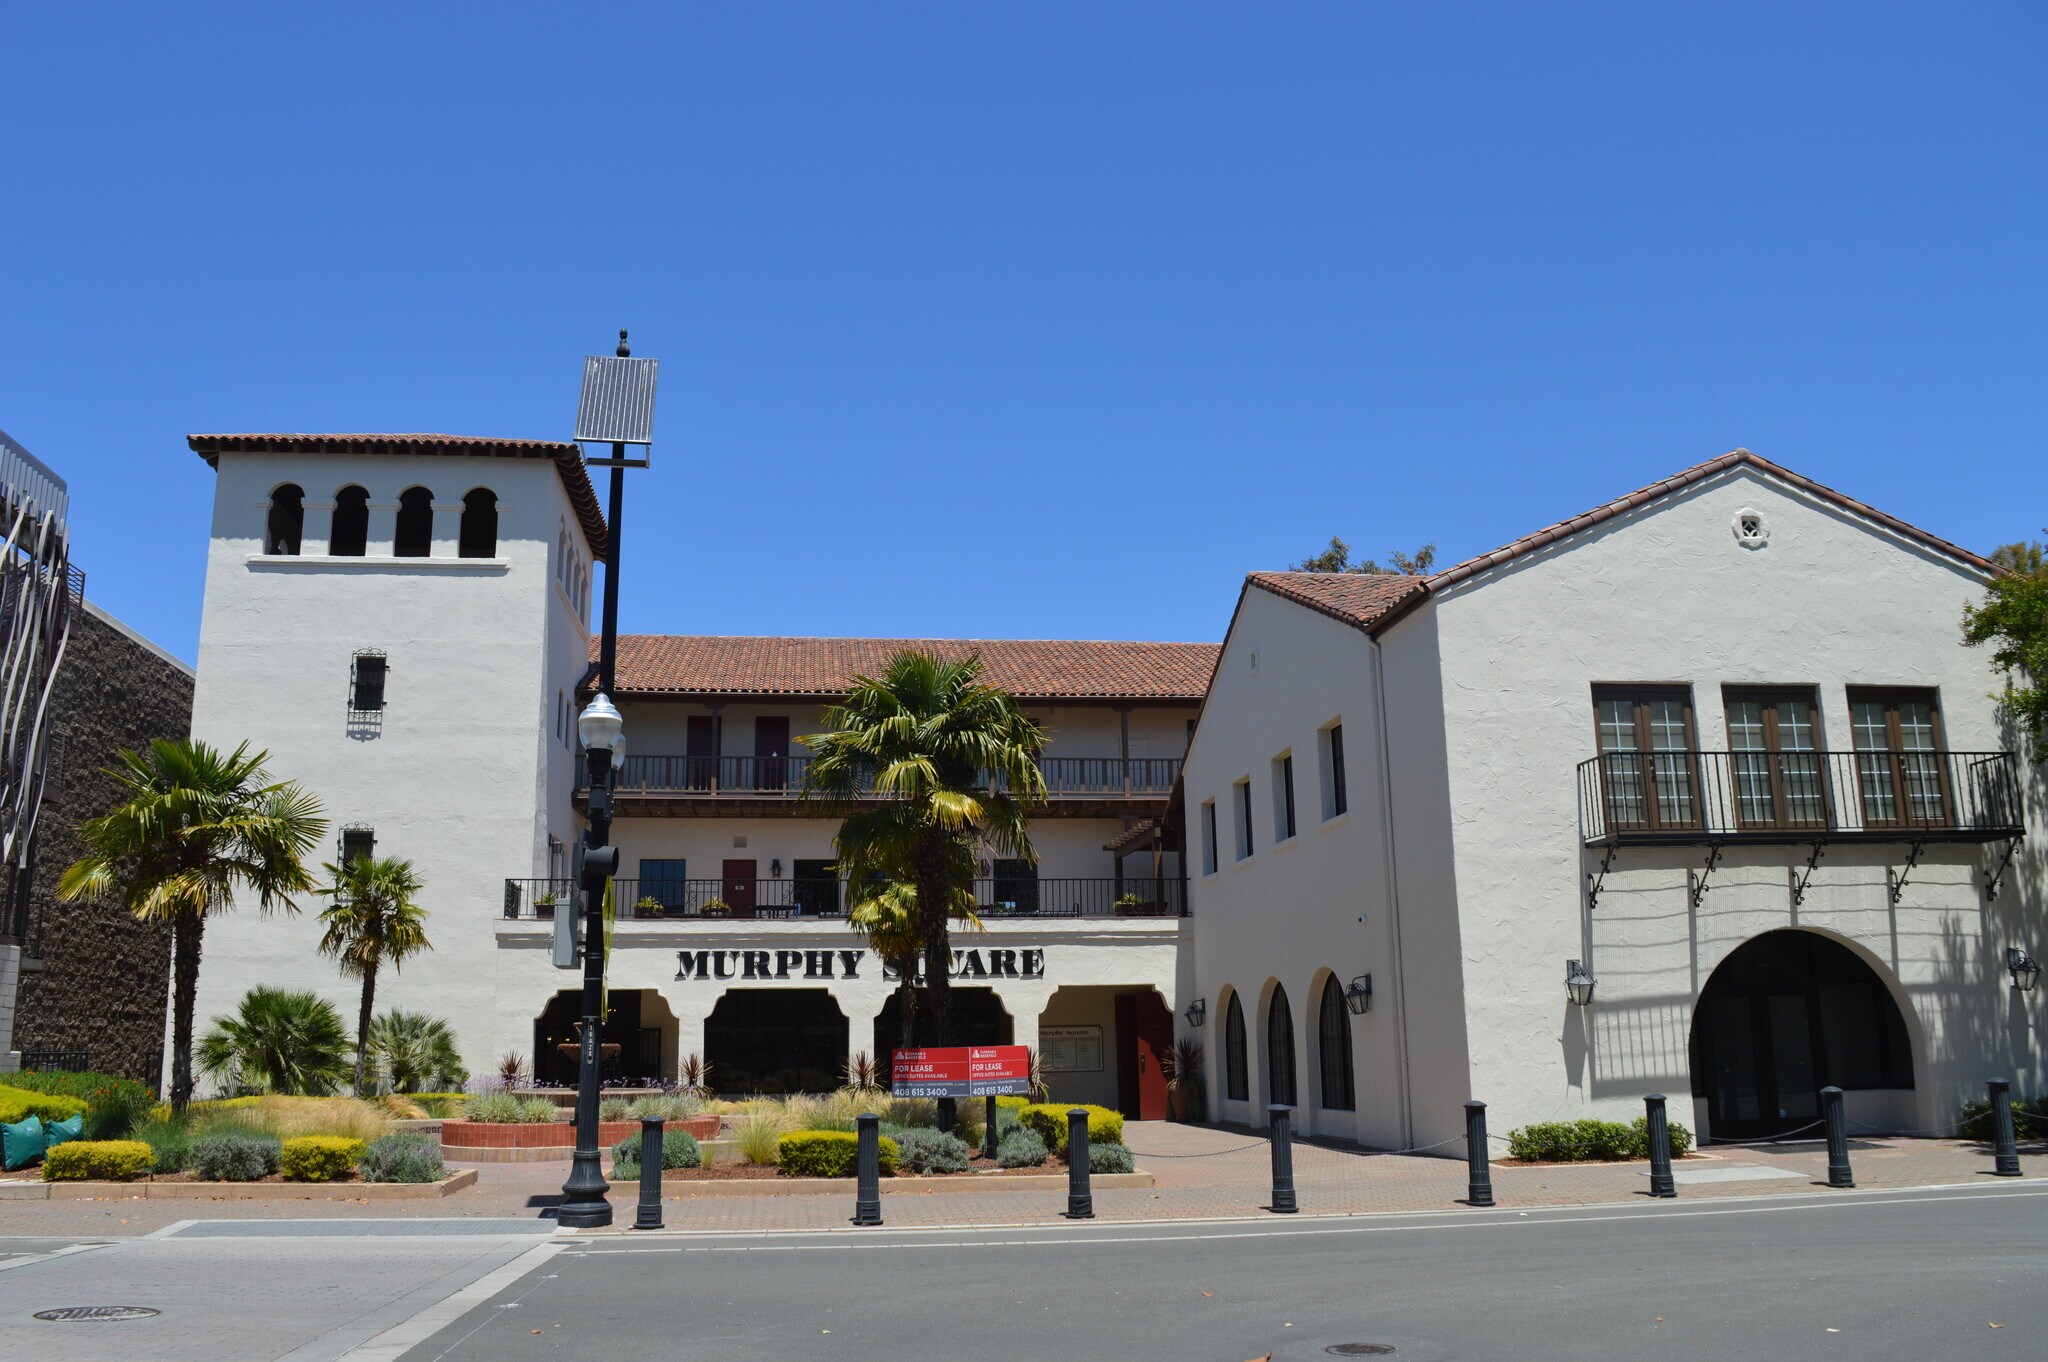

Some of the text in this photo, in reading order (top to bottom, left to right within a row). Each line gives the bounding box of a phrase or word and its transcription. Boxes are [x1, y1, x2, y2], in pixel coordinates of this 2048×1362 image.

[675, 950, 866, 979] MURPHY
[972, 1063, 984, 1071] FOR
[895, 1088, 948, 1096] 408 615 3400
[973, 1085, 1012, 1095] 408 615 3400
